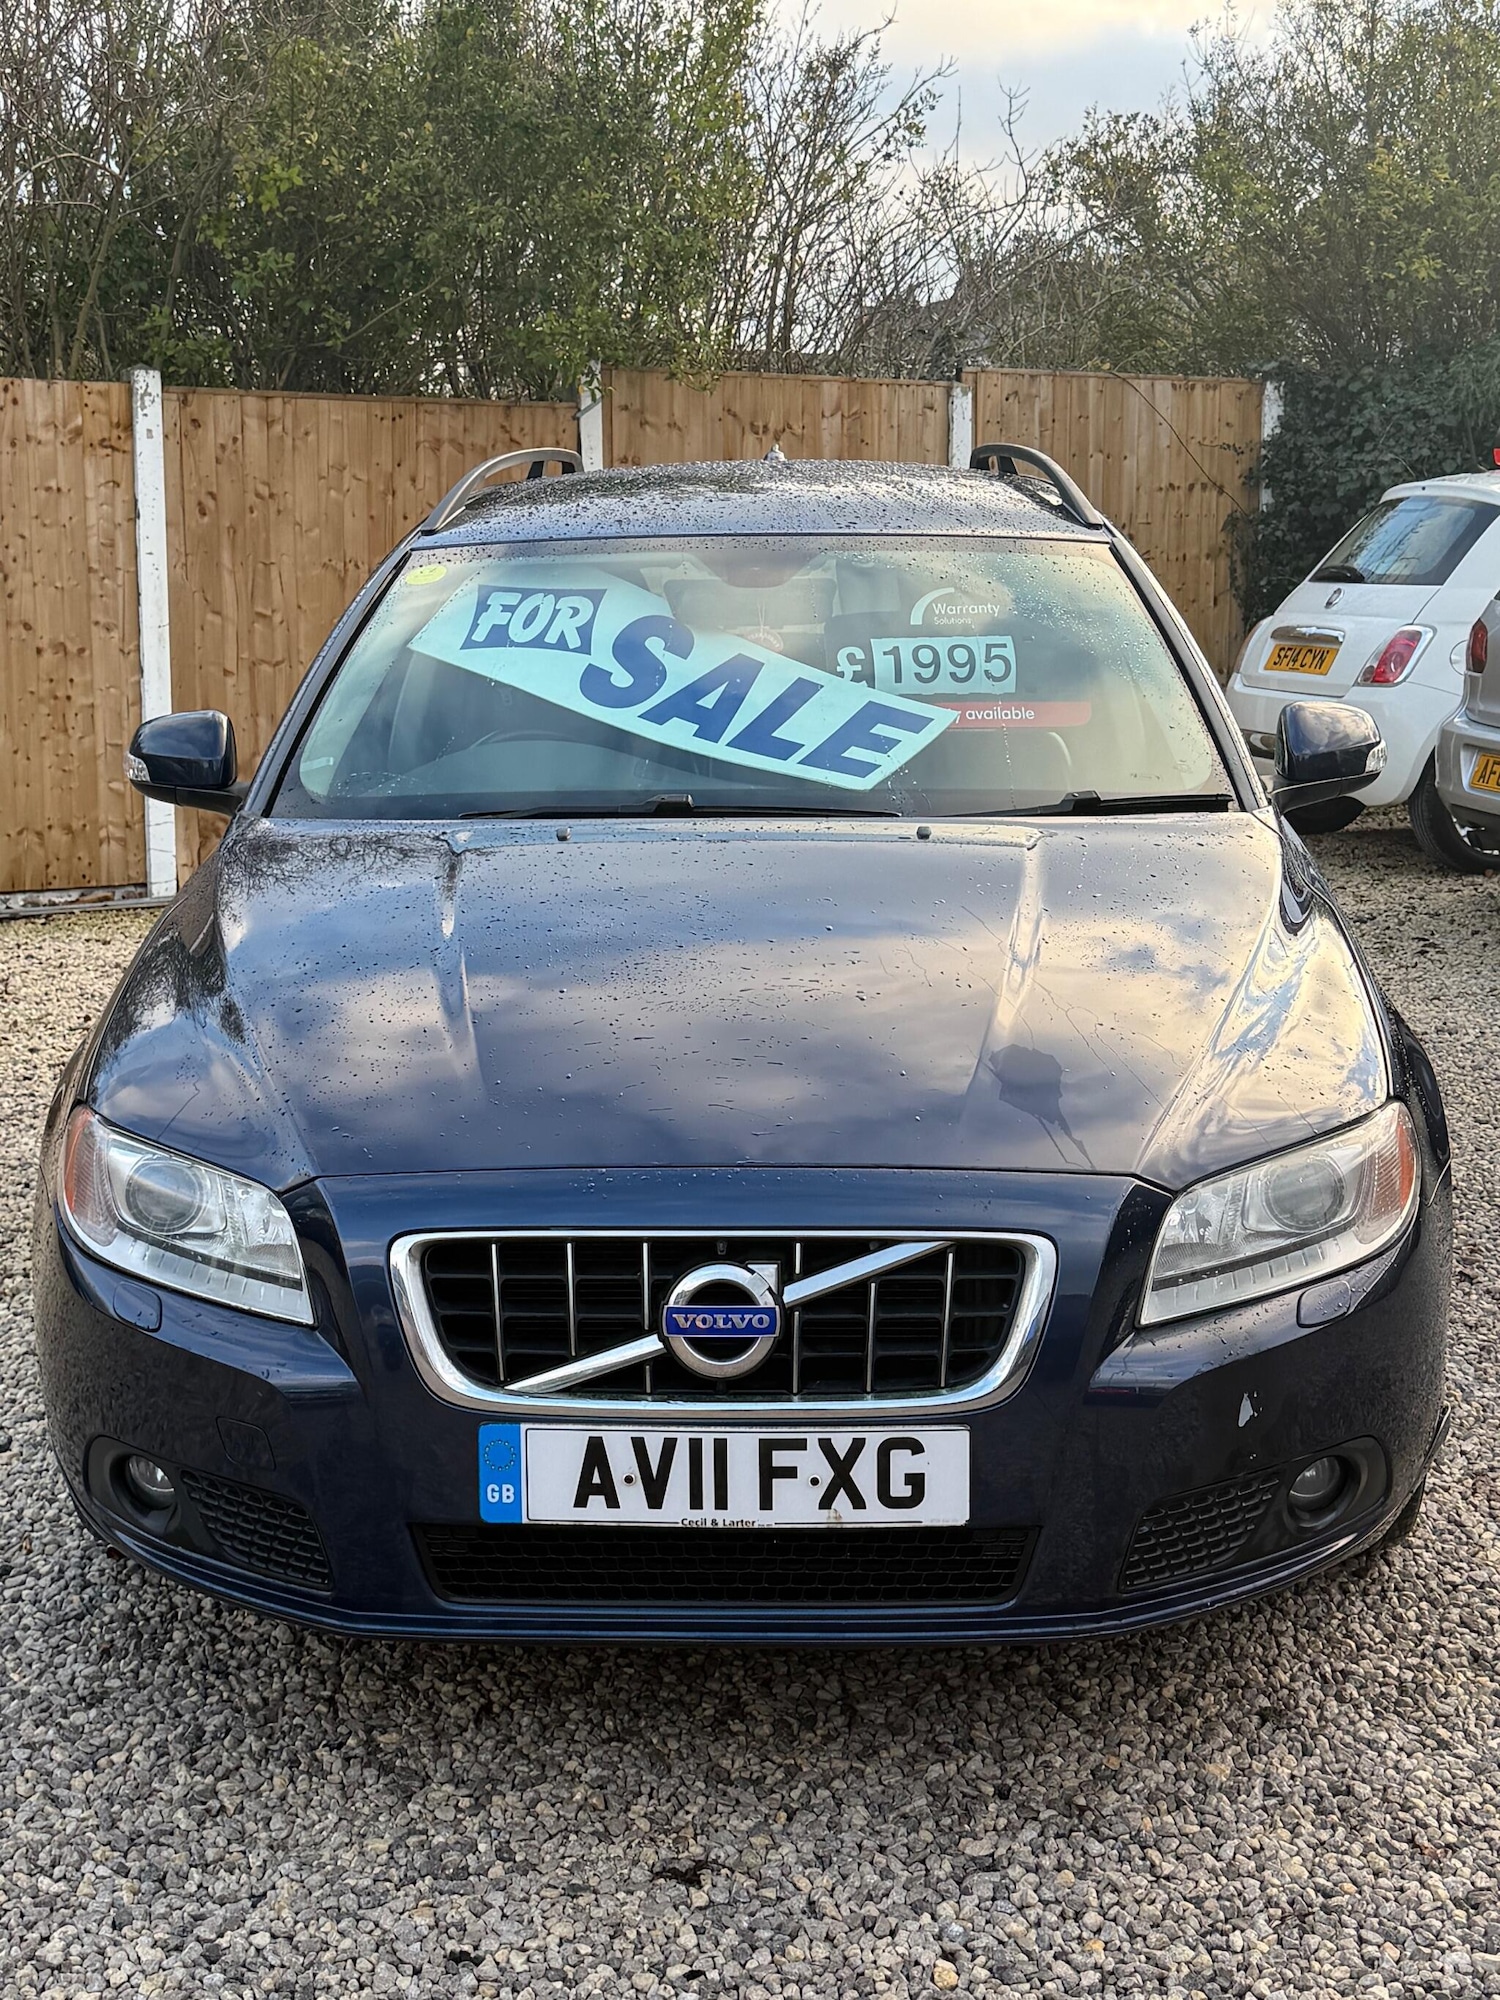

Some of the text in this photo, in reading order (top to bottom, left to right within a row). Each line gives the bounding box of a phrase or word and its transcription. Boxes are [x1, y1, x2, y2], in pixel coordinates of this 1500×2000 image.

[932, 602, 1000, 616] Warranty
[934, 616, 972, 625] Solutions
[1273, 647, 1329, 670] SF14 CYN
[471, 592, 932, 778] FOR SALE
[965, 706, 1035, 720] available
[671, 1313, 770, 1328] VOLVO
[573, 1436, 925, 1511] AV11 FXG
[487, 1484, 515, 1503] GB
[681, 1518, 707, 1527] Cecil
[711, 1518, 719, 1527] &
[722, 1518, 756, 1527] Larter
